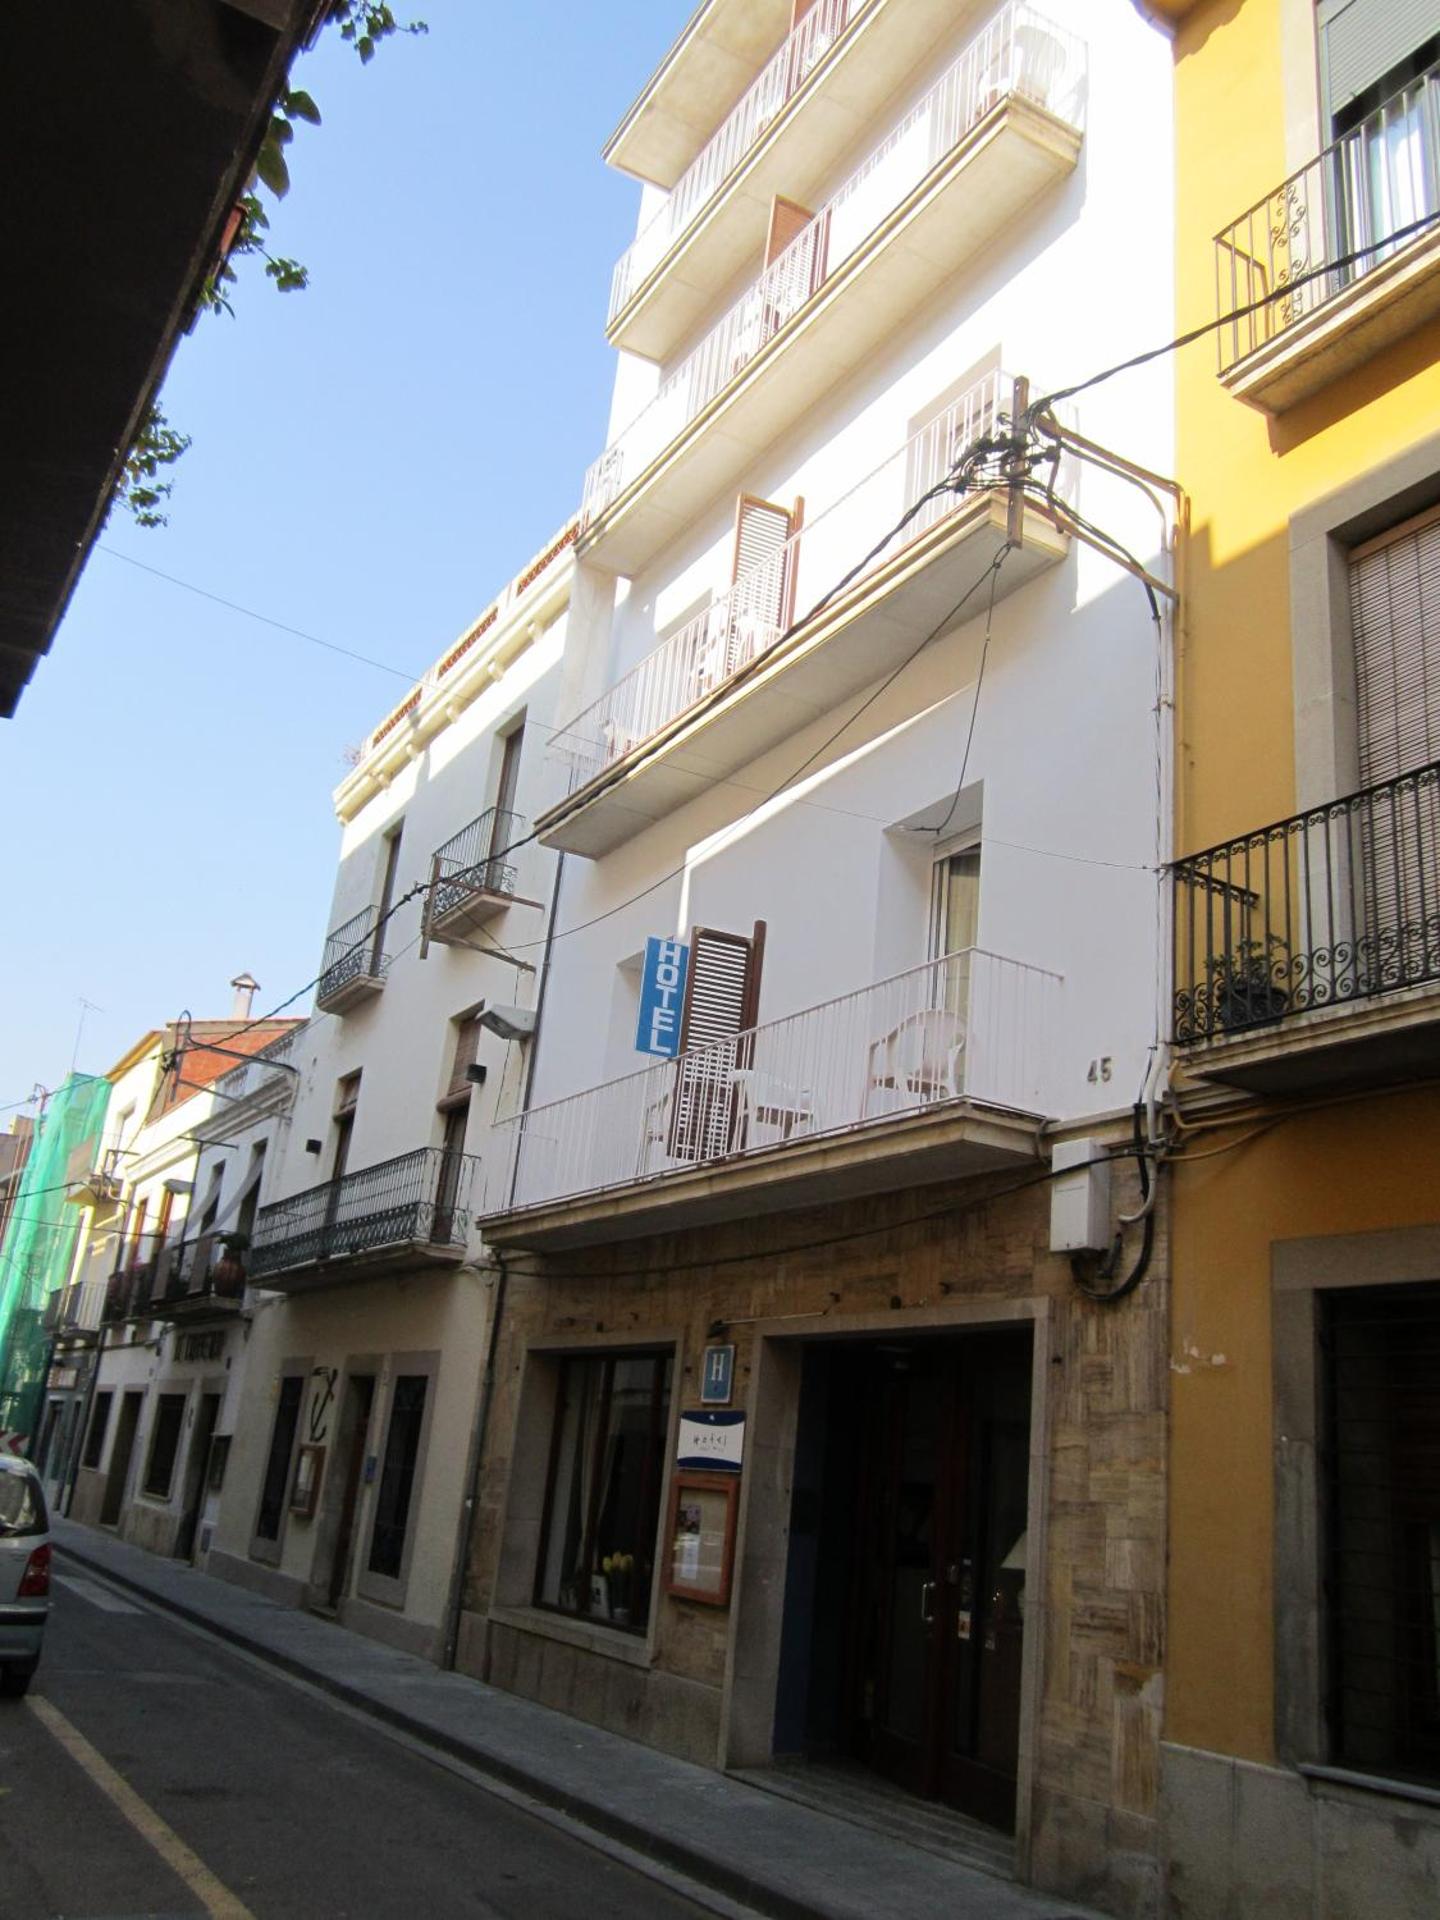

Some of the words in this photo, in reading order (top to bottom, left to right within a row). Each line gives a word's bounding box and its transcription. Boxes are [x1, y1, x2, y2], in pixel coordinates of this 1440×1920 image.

[650, 941, 682, 1053] HOTEL
[1087, 1057, 1112, 1085] 45
[711, 1353, 725, 1381] H
